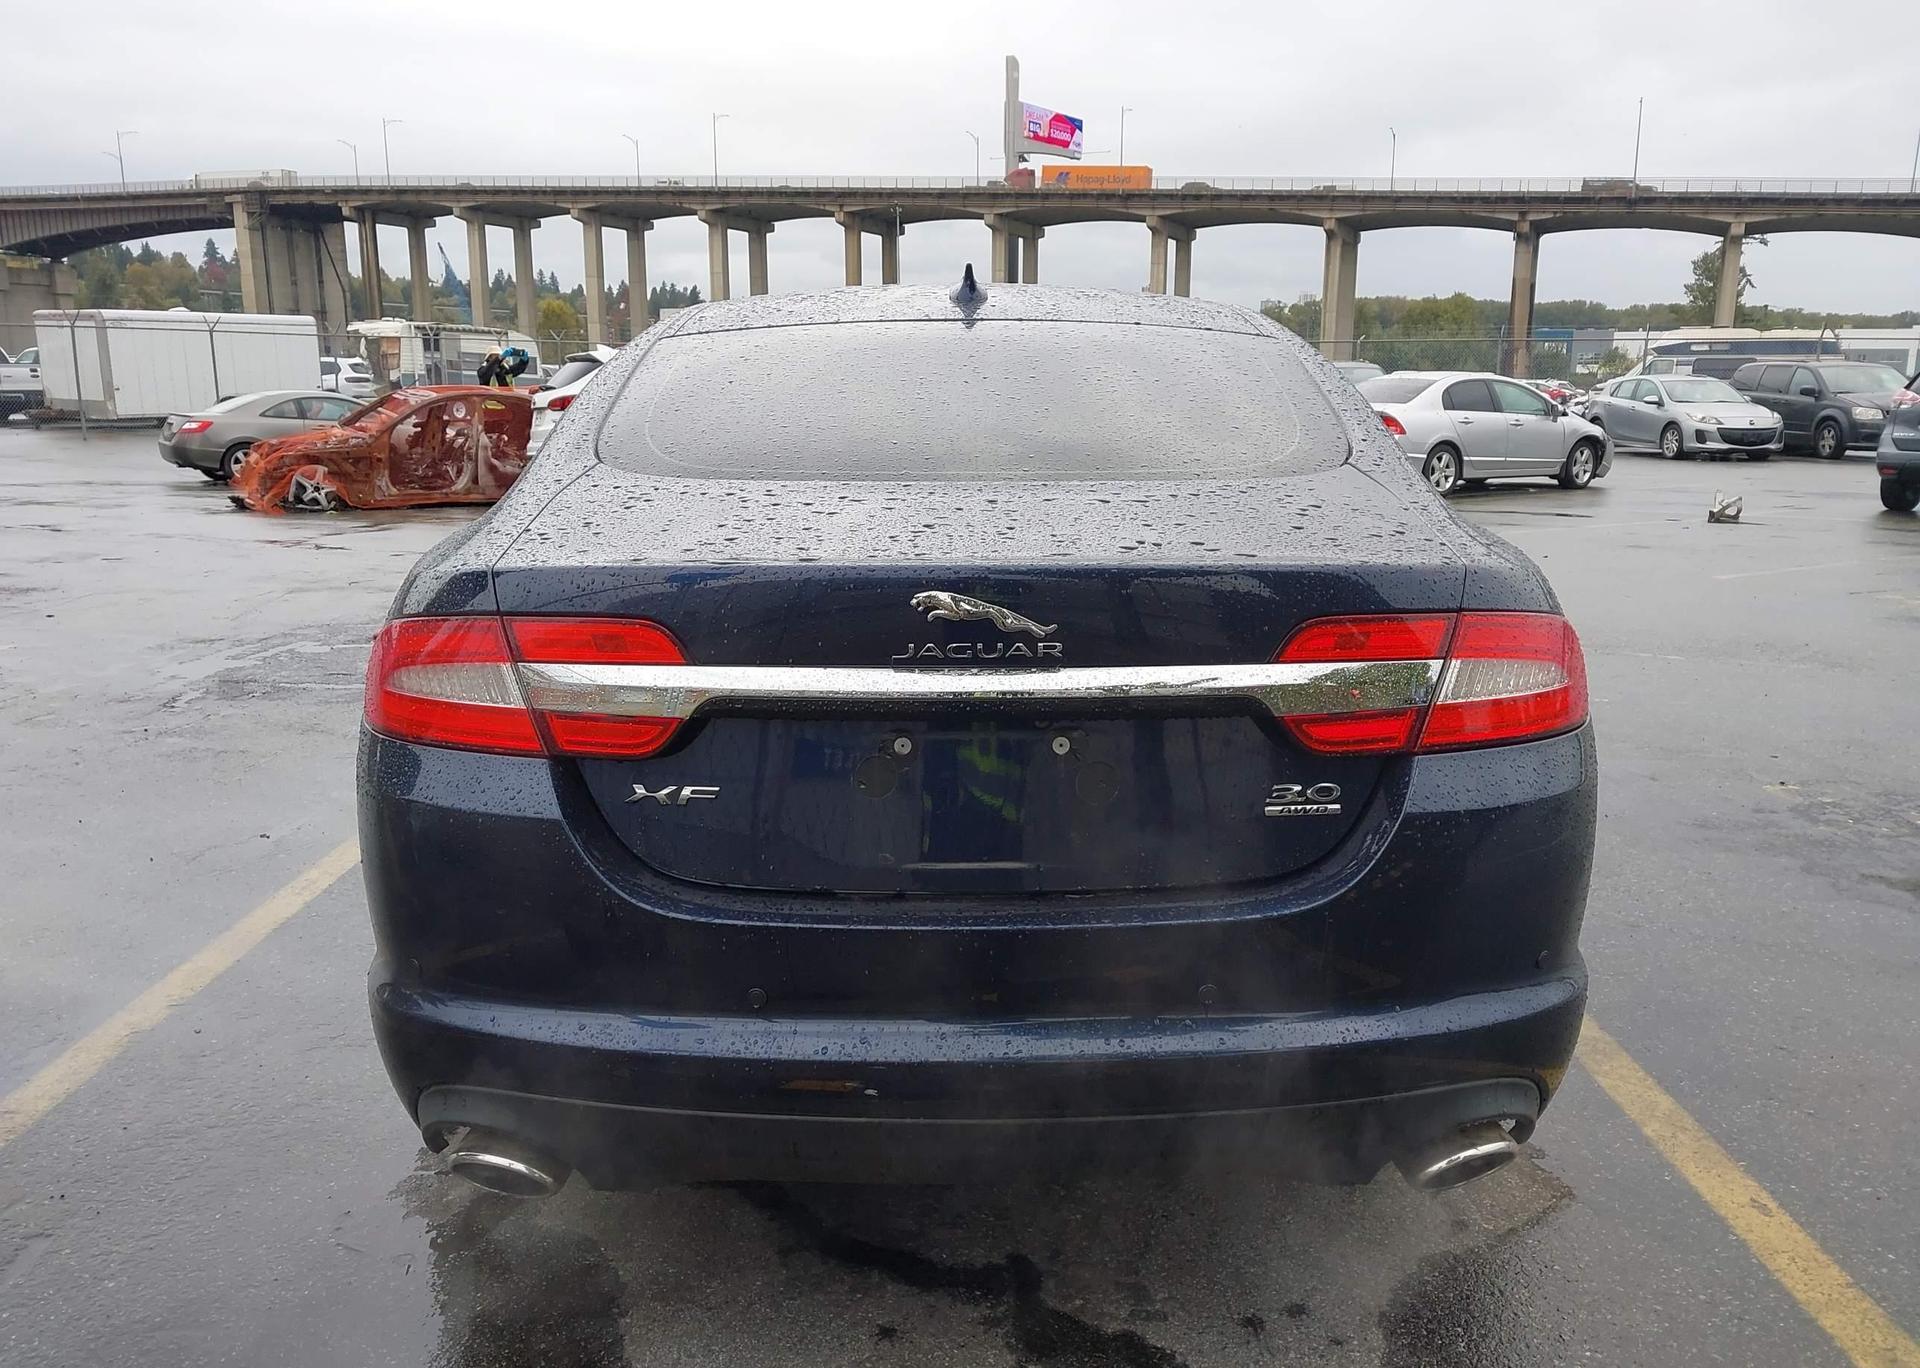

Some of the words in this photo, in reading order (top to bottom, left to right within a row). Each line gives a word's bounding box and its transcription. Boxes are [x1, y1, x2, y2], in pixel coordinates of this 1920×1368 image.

[1029, 121, 1041, 133] BIG
[1076, 174, 1131, 186] Hapag-Lloyd
[892, 643, 1063, 658] JAGUAR
[624, 784, 720, 805] XF
[1265, 783, 1341, 803] 3.0
[1279, 806, 1329, 815] AWD
